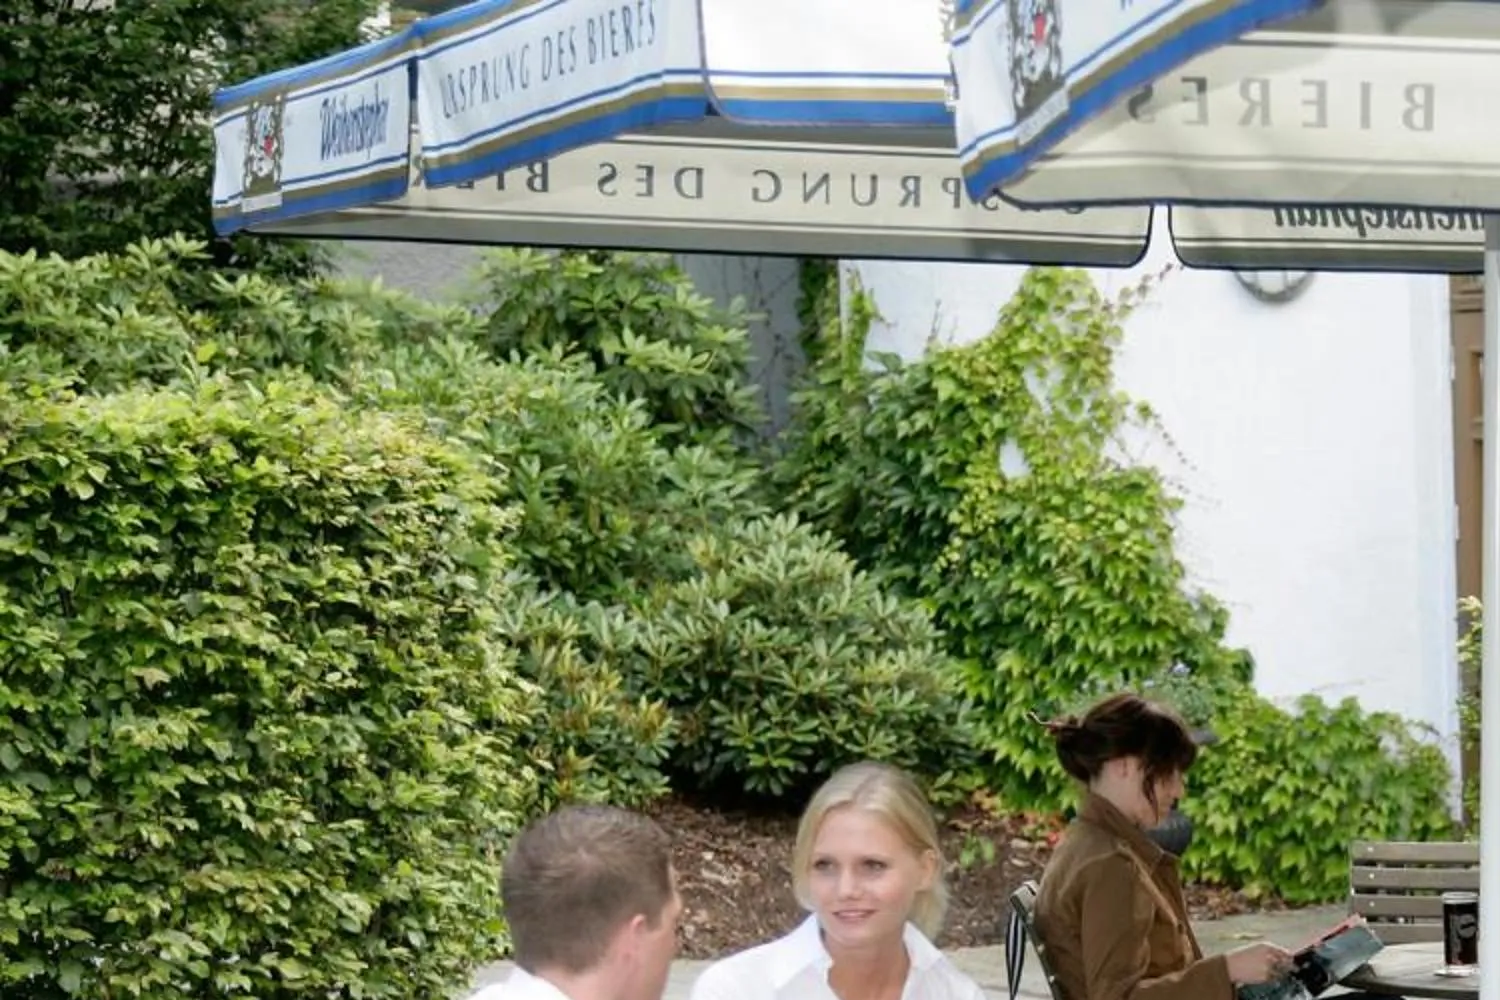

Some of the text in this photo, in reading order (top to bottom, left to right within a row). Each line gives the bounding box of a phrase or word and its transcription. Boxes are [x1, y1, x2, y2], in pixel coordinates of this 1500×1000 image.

[439, 0, 656, 119] URSPRUNG DES BIERES
